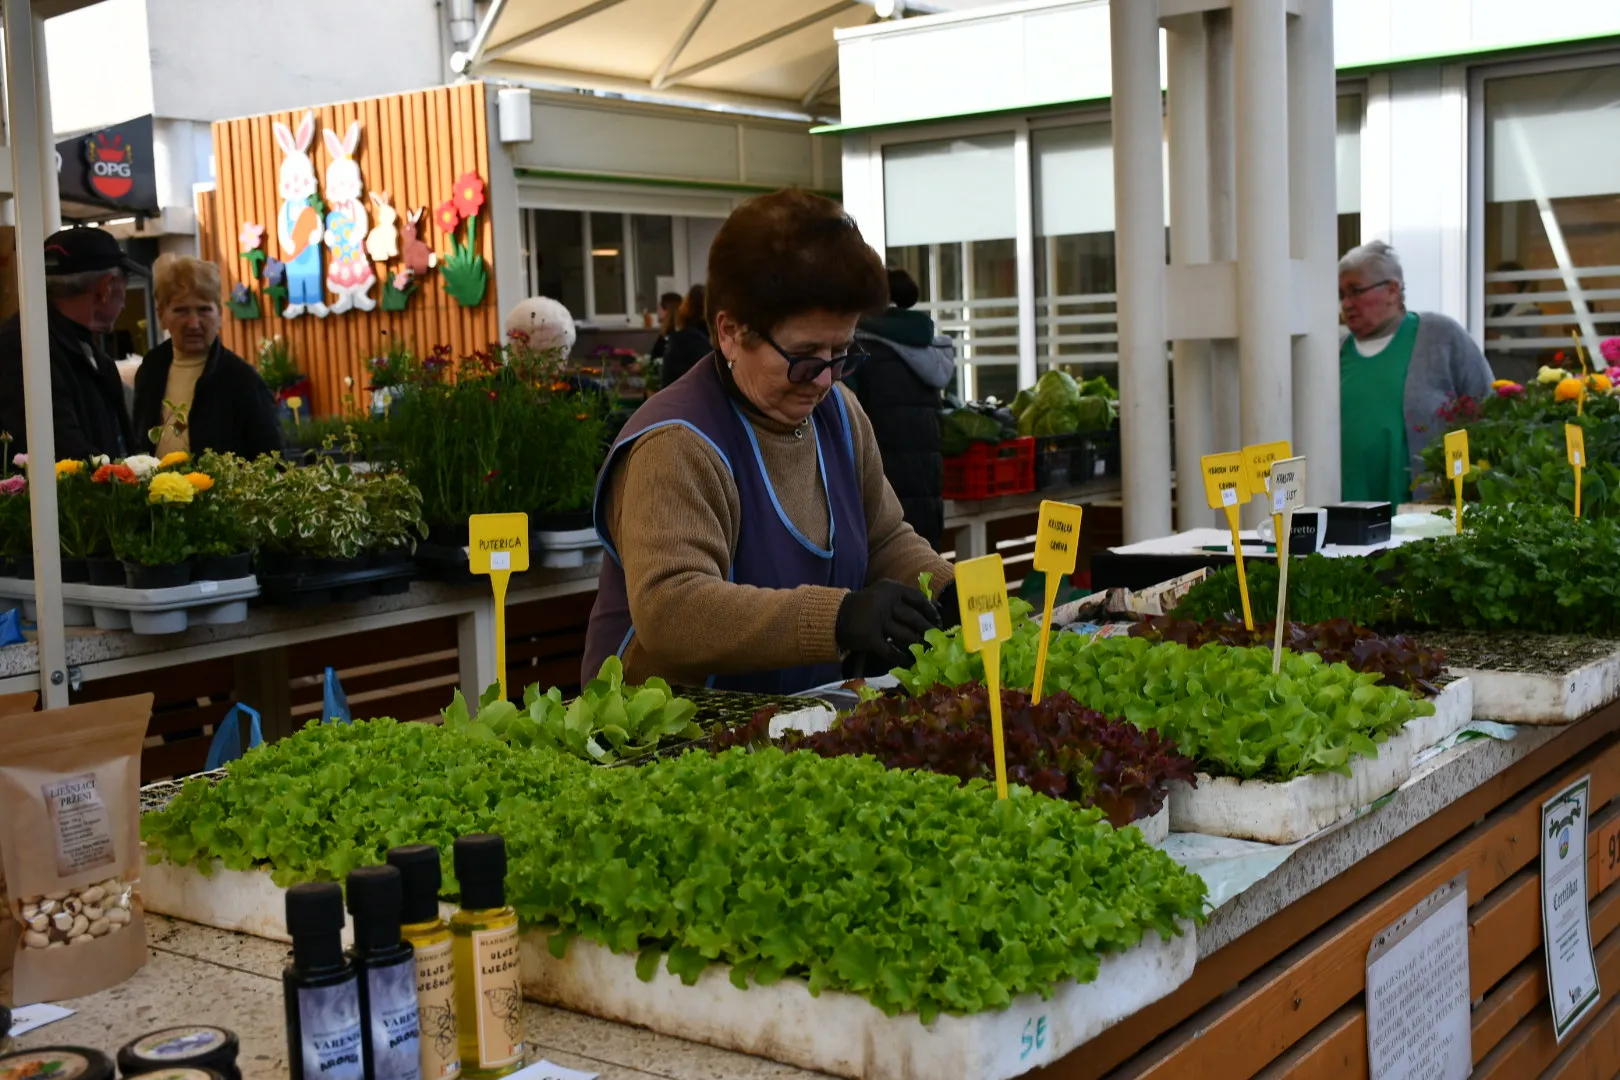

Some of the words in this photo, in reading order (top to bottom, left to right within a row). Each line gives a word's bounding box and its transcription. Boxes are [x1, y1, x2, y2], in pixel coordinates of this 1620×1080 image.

[94, 161, 131, 177] OPG
[1286, 489, 1298, 501] LIST
[479, 536, 522, 550] PUTERICA
[50, 780, 96, 799] LJEŠNJACI
[61, 792, 92, 807] PRŽENI
